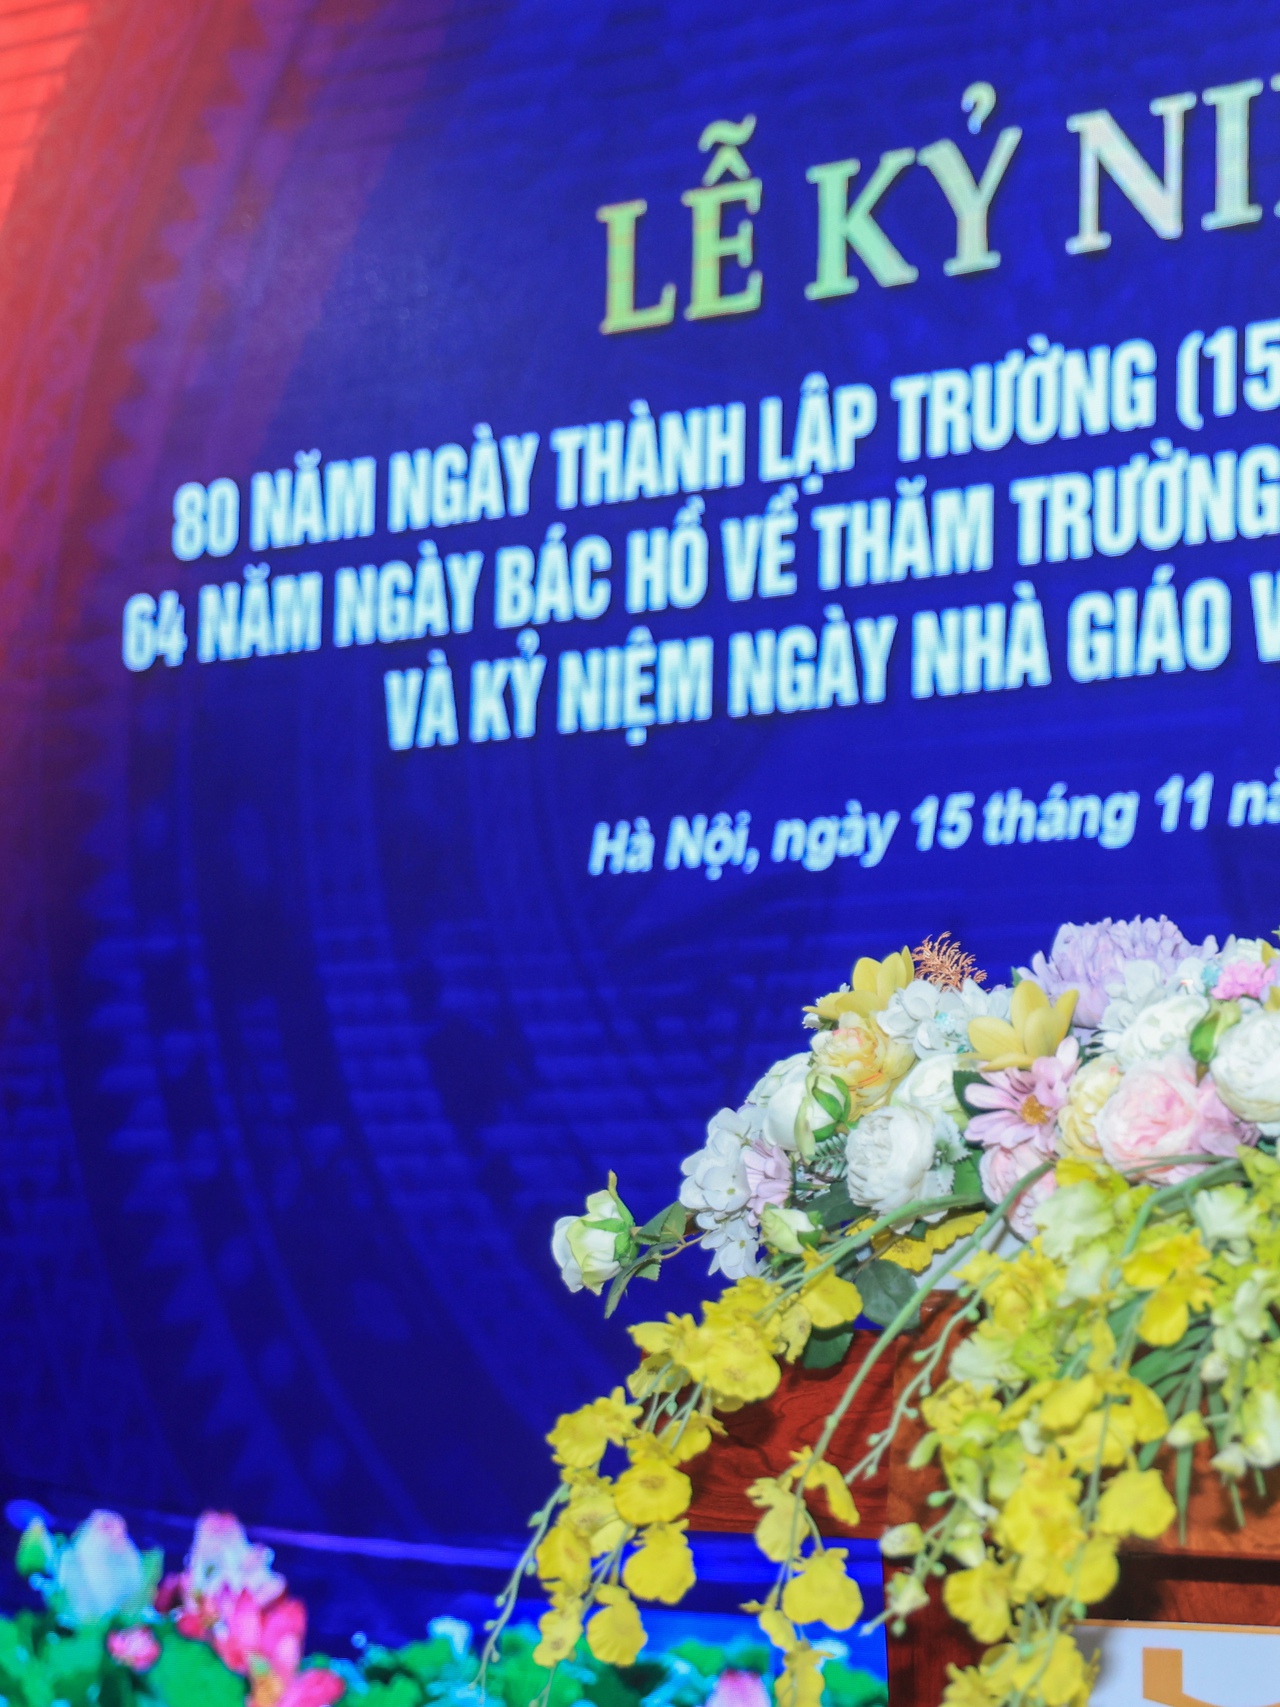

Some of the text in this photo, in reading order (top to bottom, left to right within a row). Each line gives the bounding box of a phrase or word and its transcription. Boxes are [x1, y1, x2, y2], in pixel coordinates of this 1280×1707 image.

[597, 115, 762, 334] LỄ
[805, 81, 1022, 301] KỶ
[172, 477, 239, 561] 80
[250, 448, 376, 551] NĂM
[388, 422, 539, 533] NGÀY
[551, 399, 746, 509] THÀNH
[758, 371, 878, 495] LẬP
[890, 334, 1157, 462] TRƯỜNG
[122, 590, 185, 672] 64
[197, 562, 322, 662] NĂM
[334, 540, 483, 648] NGÀY
[494, 522, 611, 628] BÁC
[625, 494, 709, 614] HỒ
[720, 484, 798, 601] VỀ
[811, 475, 994, 591] THĂM
[384, 649, 459, 750] VÀ
[469, 627, 546, 743] KỶ
[557, 625, 713, 747] NIỆM
[727, 604, 898, 718] NGÀY
[911, 580, 1051, 699] NHÀ
[1067, 563, 1231, 683] GIÁO
[588, 816, 655, 875] Hà
[664, 810, 760, 881] Nội,
[771, 799, 900, 872] ngày
[911, 791, 975, 851] 15
[982, 781, 1140, 849] tháng
[1155, 771, 1214, 833] 11
